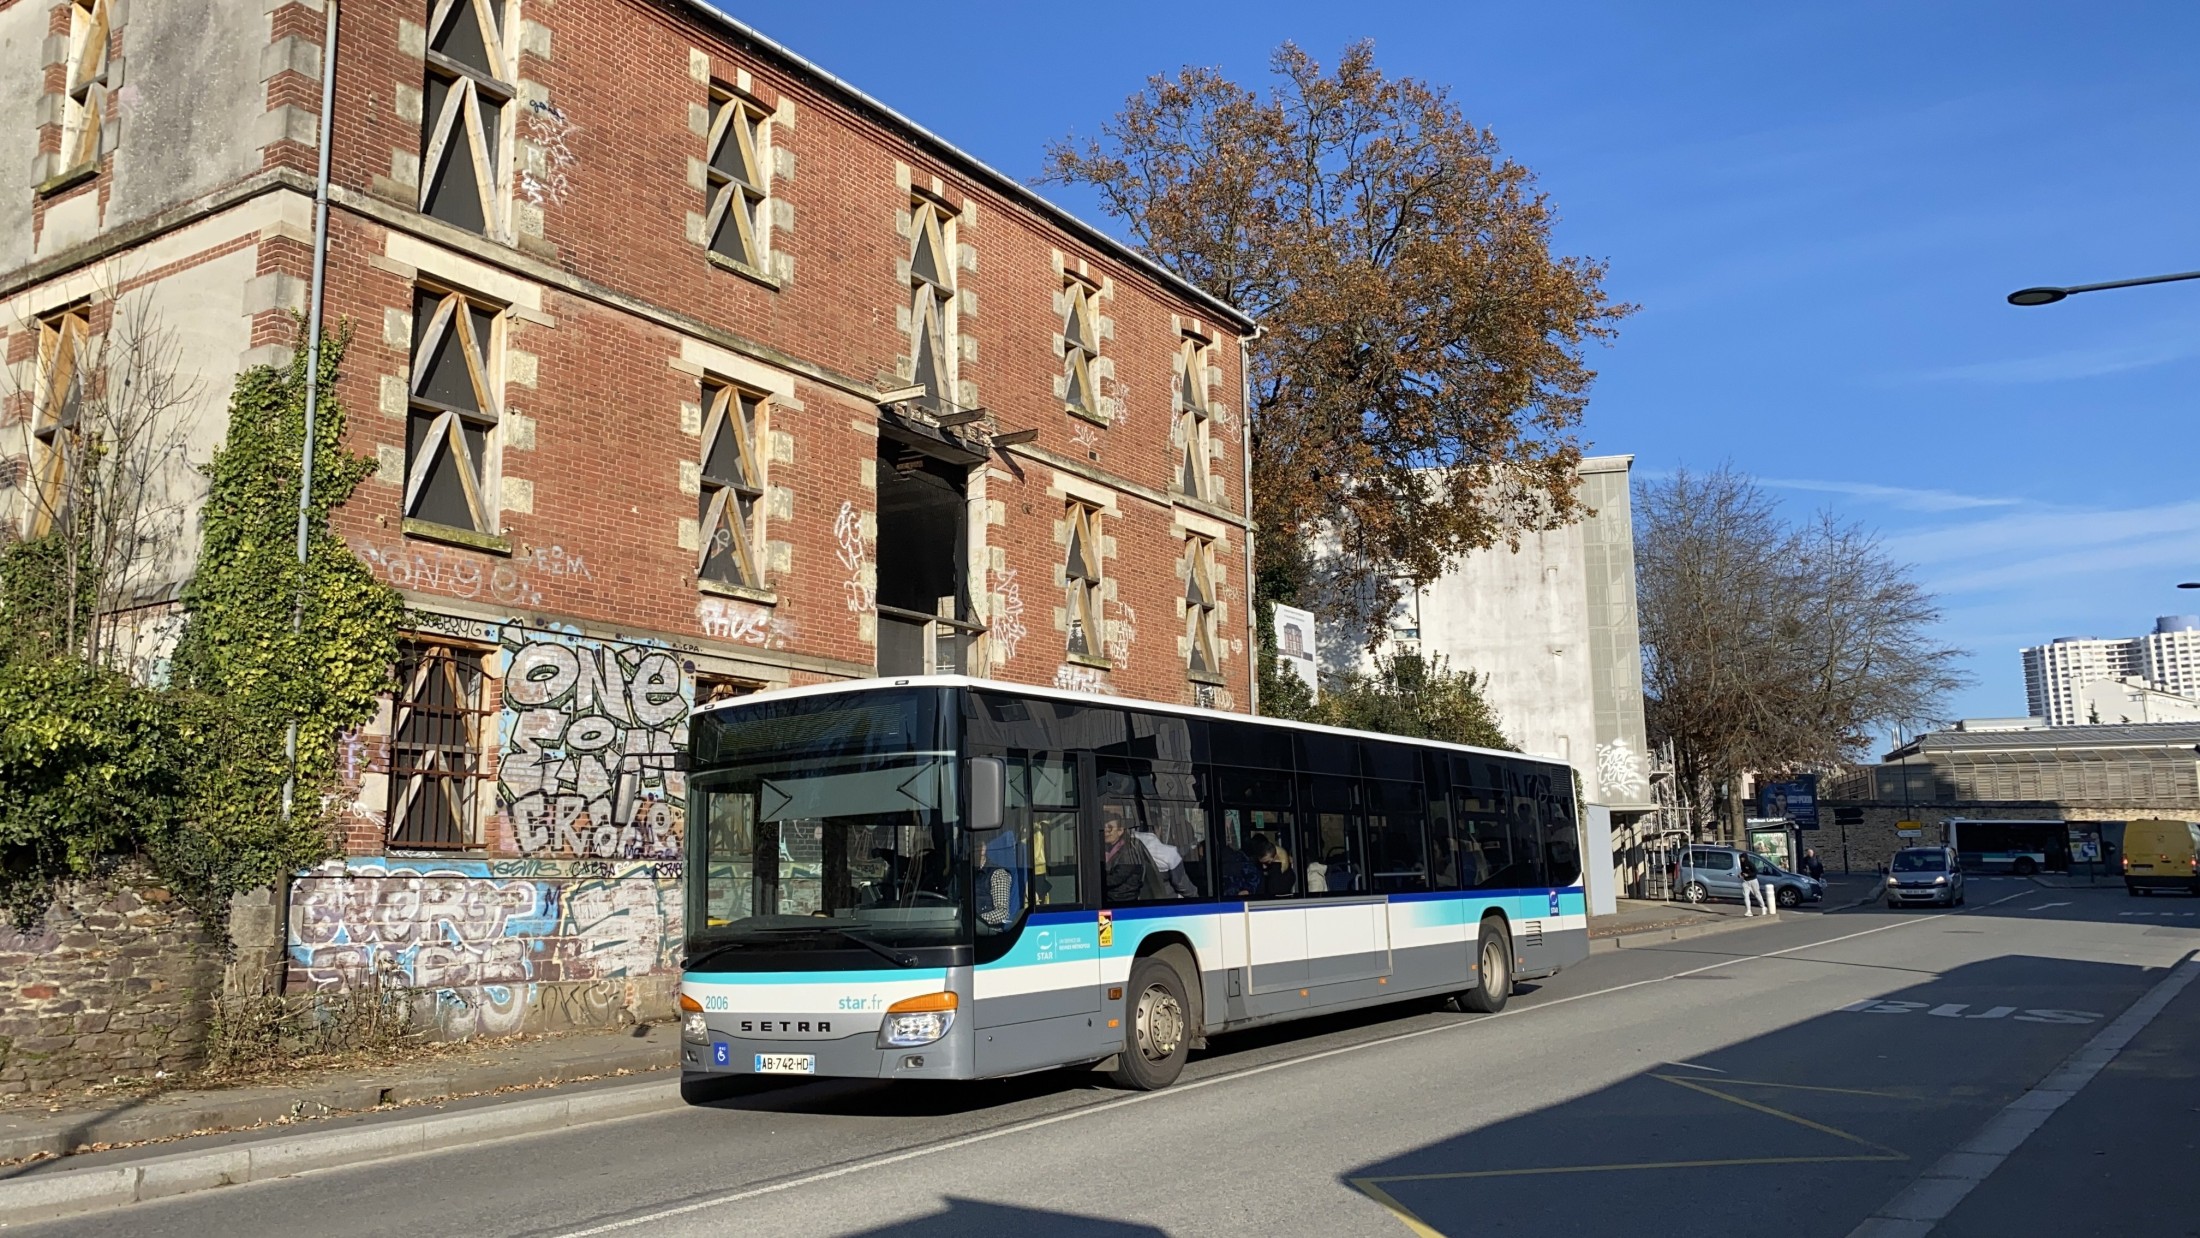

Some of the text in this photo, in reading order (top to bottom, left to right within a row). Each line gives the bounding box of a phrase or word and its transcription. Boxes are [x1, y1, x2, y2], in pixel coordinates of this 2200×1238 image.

[1037, 951, 1053, 960] STAR
[705, 996, 729, 1010] 2006
[838, 994, 882, 1011] star.fr
[1832, 999, 2104, 1024] BUS
[741, 1021, 831, 1033] SETRA
[762, 1057, 809, 1071] AB-742-HD
